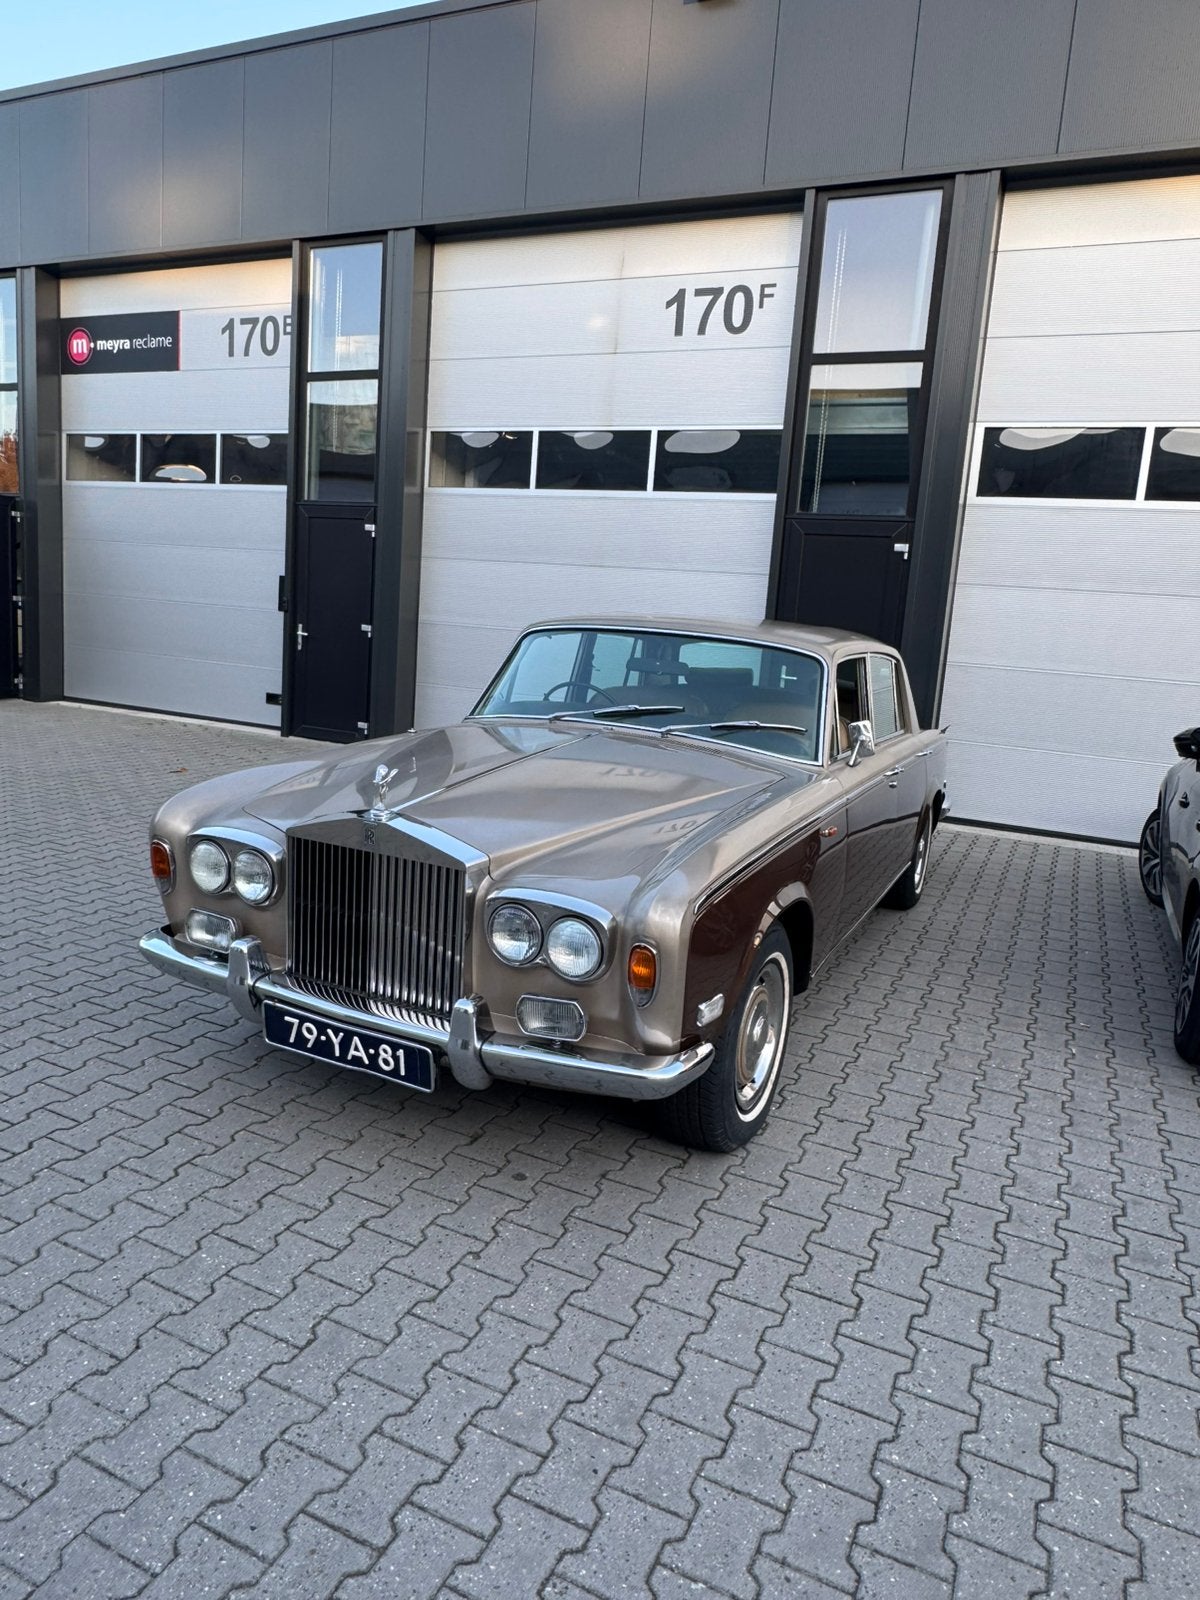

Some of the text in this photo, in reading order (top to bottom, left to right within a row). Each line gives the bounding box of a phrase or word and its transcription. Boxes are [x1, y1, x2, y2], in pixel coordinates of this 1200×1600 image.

[73, 338, 88, 354] m
[96, 334, 173, 354] meyra reclame
[284, 1016, 406, 1076] 79-YA-81
